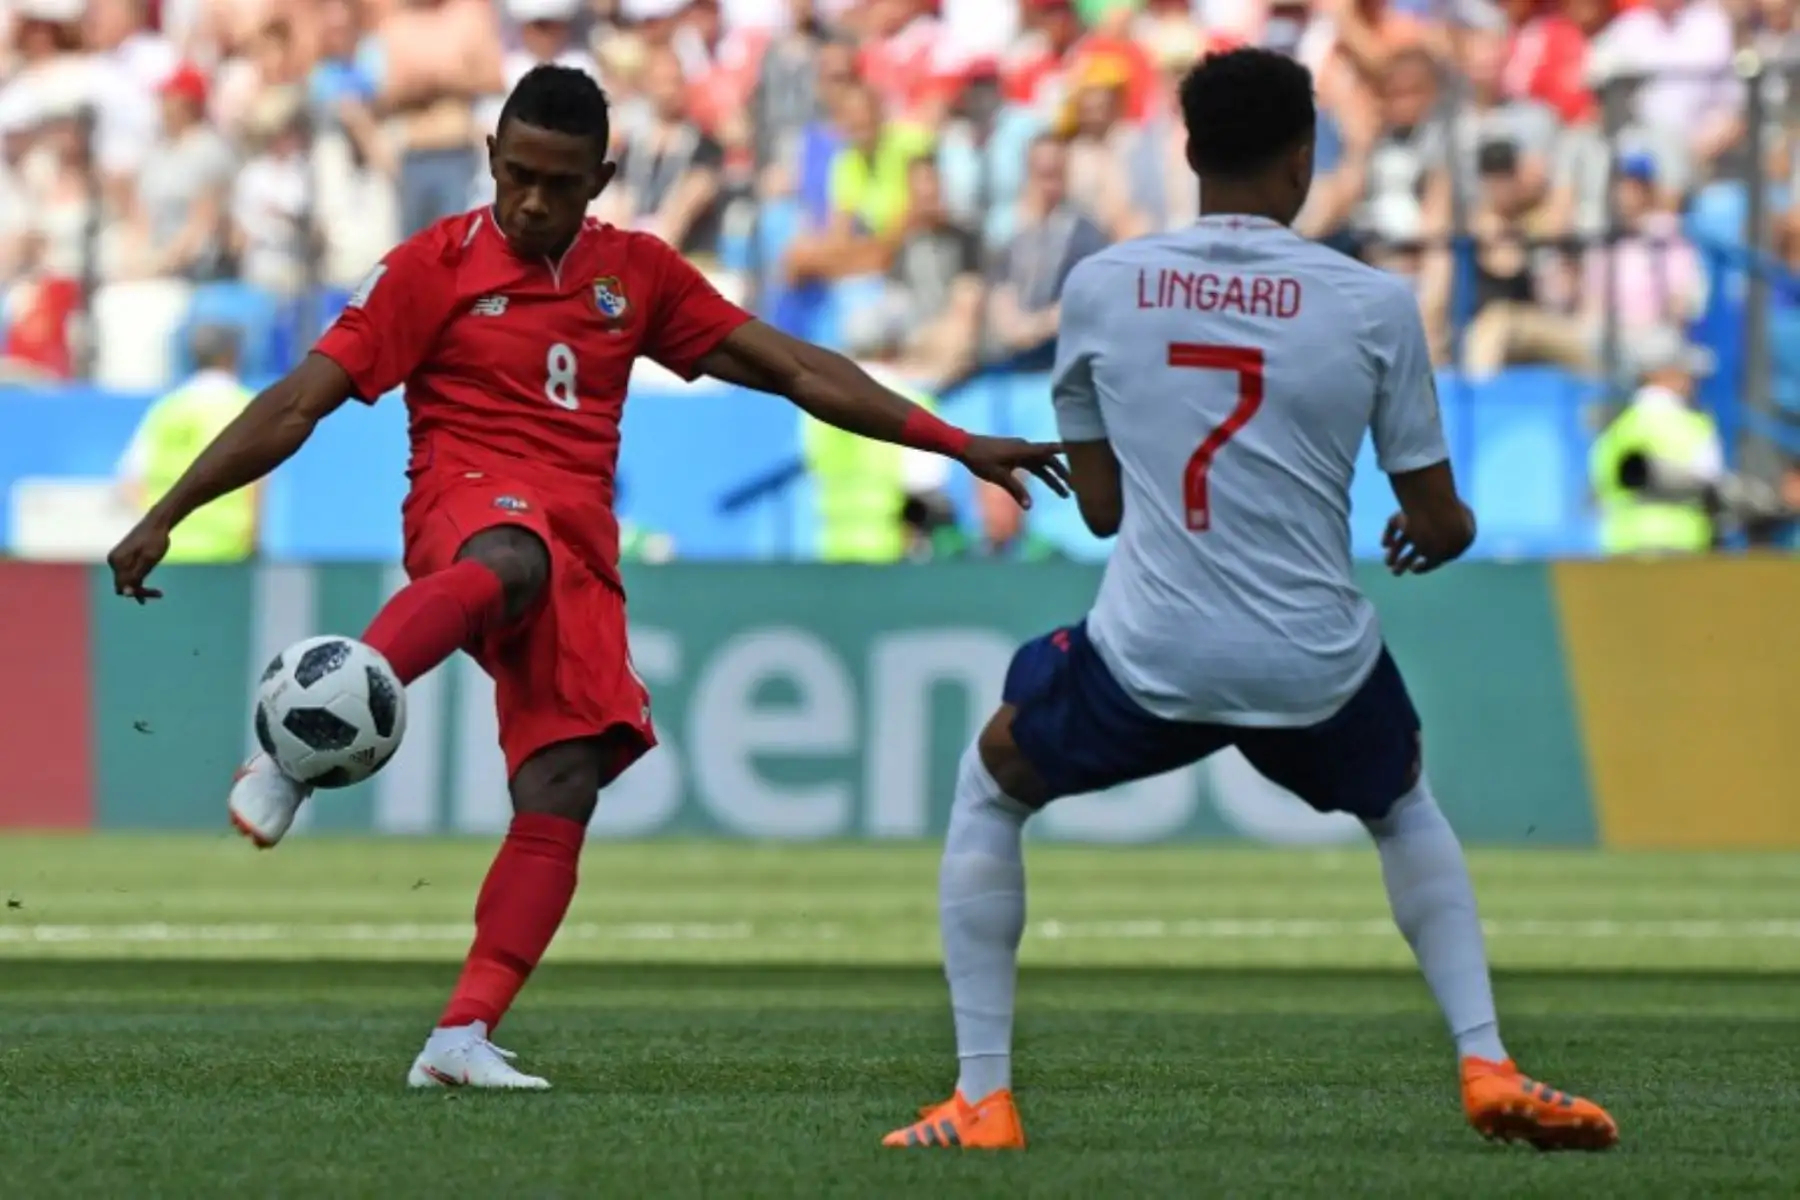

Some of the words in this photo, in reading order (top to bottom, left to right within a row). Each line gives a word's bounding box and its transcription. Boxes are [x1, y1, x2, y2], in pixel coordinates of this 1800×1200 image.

[1137, 268, 1302, 319] LINGARD
[545, 343, 579, 411] 8
[1167, 341, 1264, 532] 7
